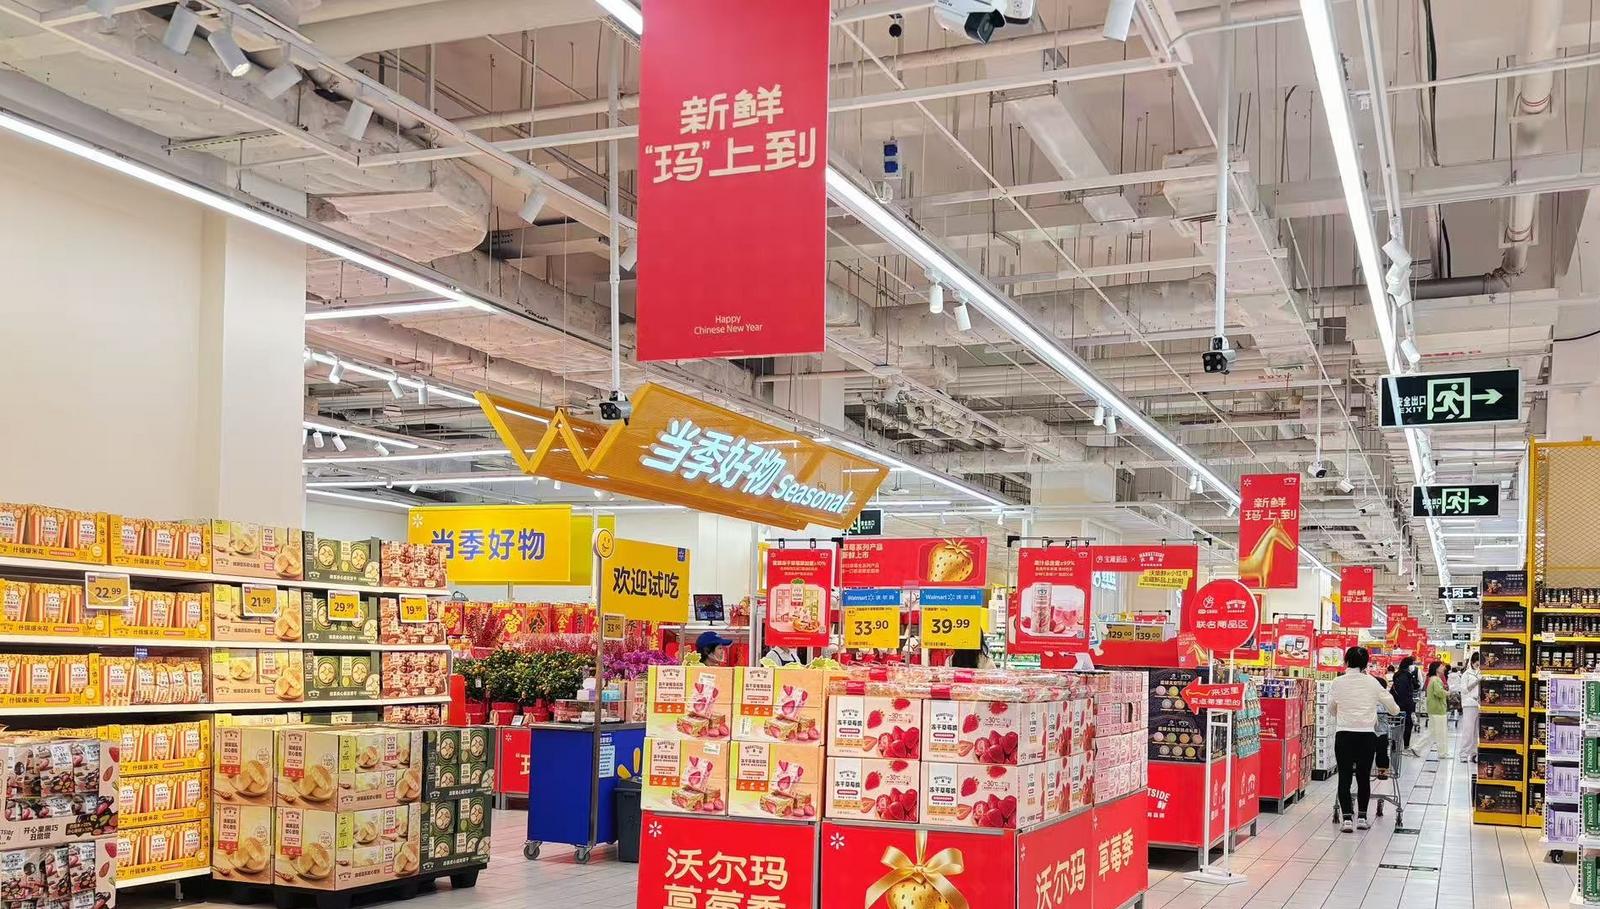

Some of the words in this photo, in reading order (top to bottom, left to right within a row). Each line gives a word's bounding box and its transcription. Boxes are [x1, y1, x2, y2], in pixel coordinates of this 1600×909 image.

[679, 84, 785, 135] 新鲜
[715, 314, 741, 325] Happy
[694, 324, 725, 335] Chinese
[726, 323, 744, 333] New
[745, 322, 763, 332] Year
[641, 418, 787, 496] 当季好物
[773, 474, 854, 514] Seasonal
[1253, 497, 1288, 508] 新鲜
[431, 527, 545, 561] 当季好物
[612, 566, 680, 599] 欢迎试吃
[95, 586, 122, 600] 22.99
[250, 597, 272, 608] 21.99
[333, 602, 355, 612] 29.99
[854, 620, 889, 636] 33.90
[931, 618, 971, 634] 39.99
[1136, 632, 1160, 640] 139.00
[1098, 827, 1134, 883] 草莓季
[663, 847, 790, 891] 沃尔玛
[1036, 847, 1086, 909] 沃尔玛
